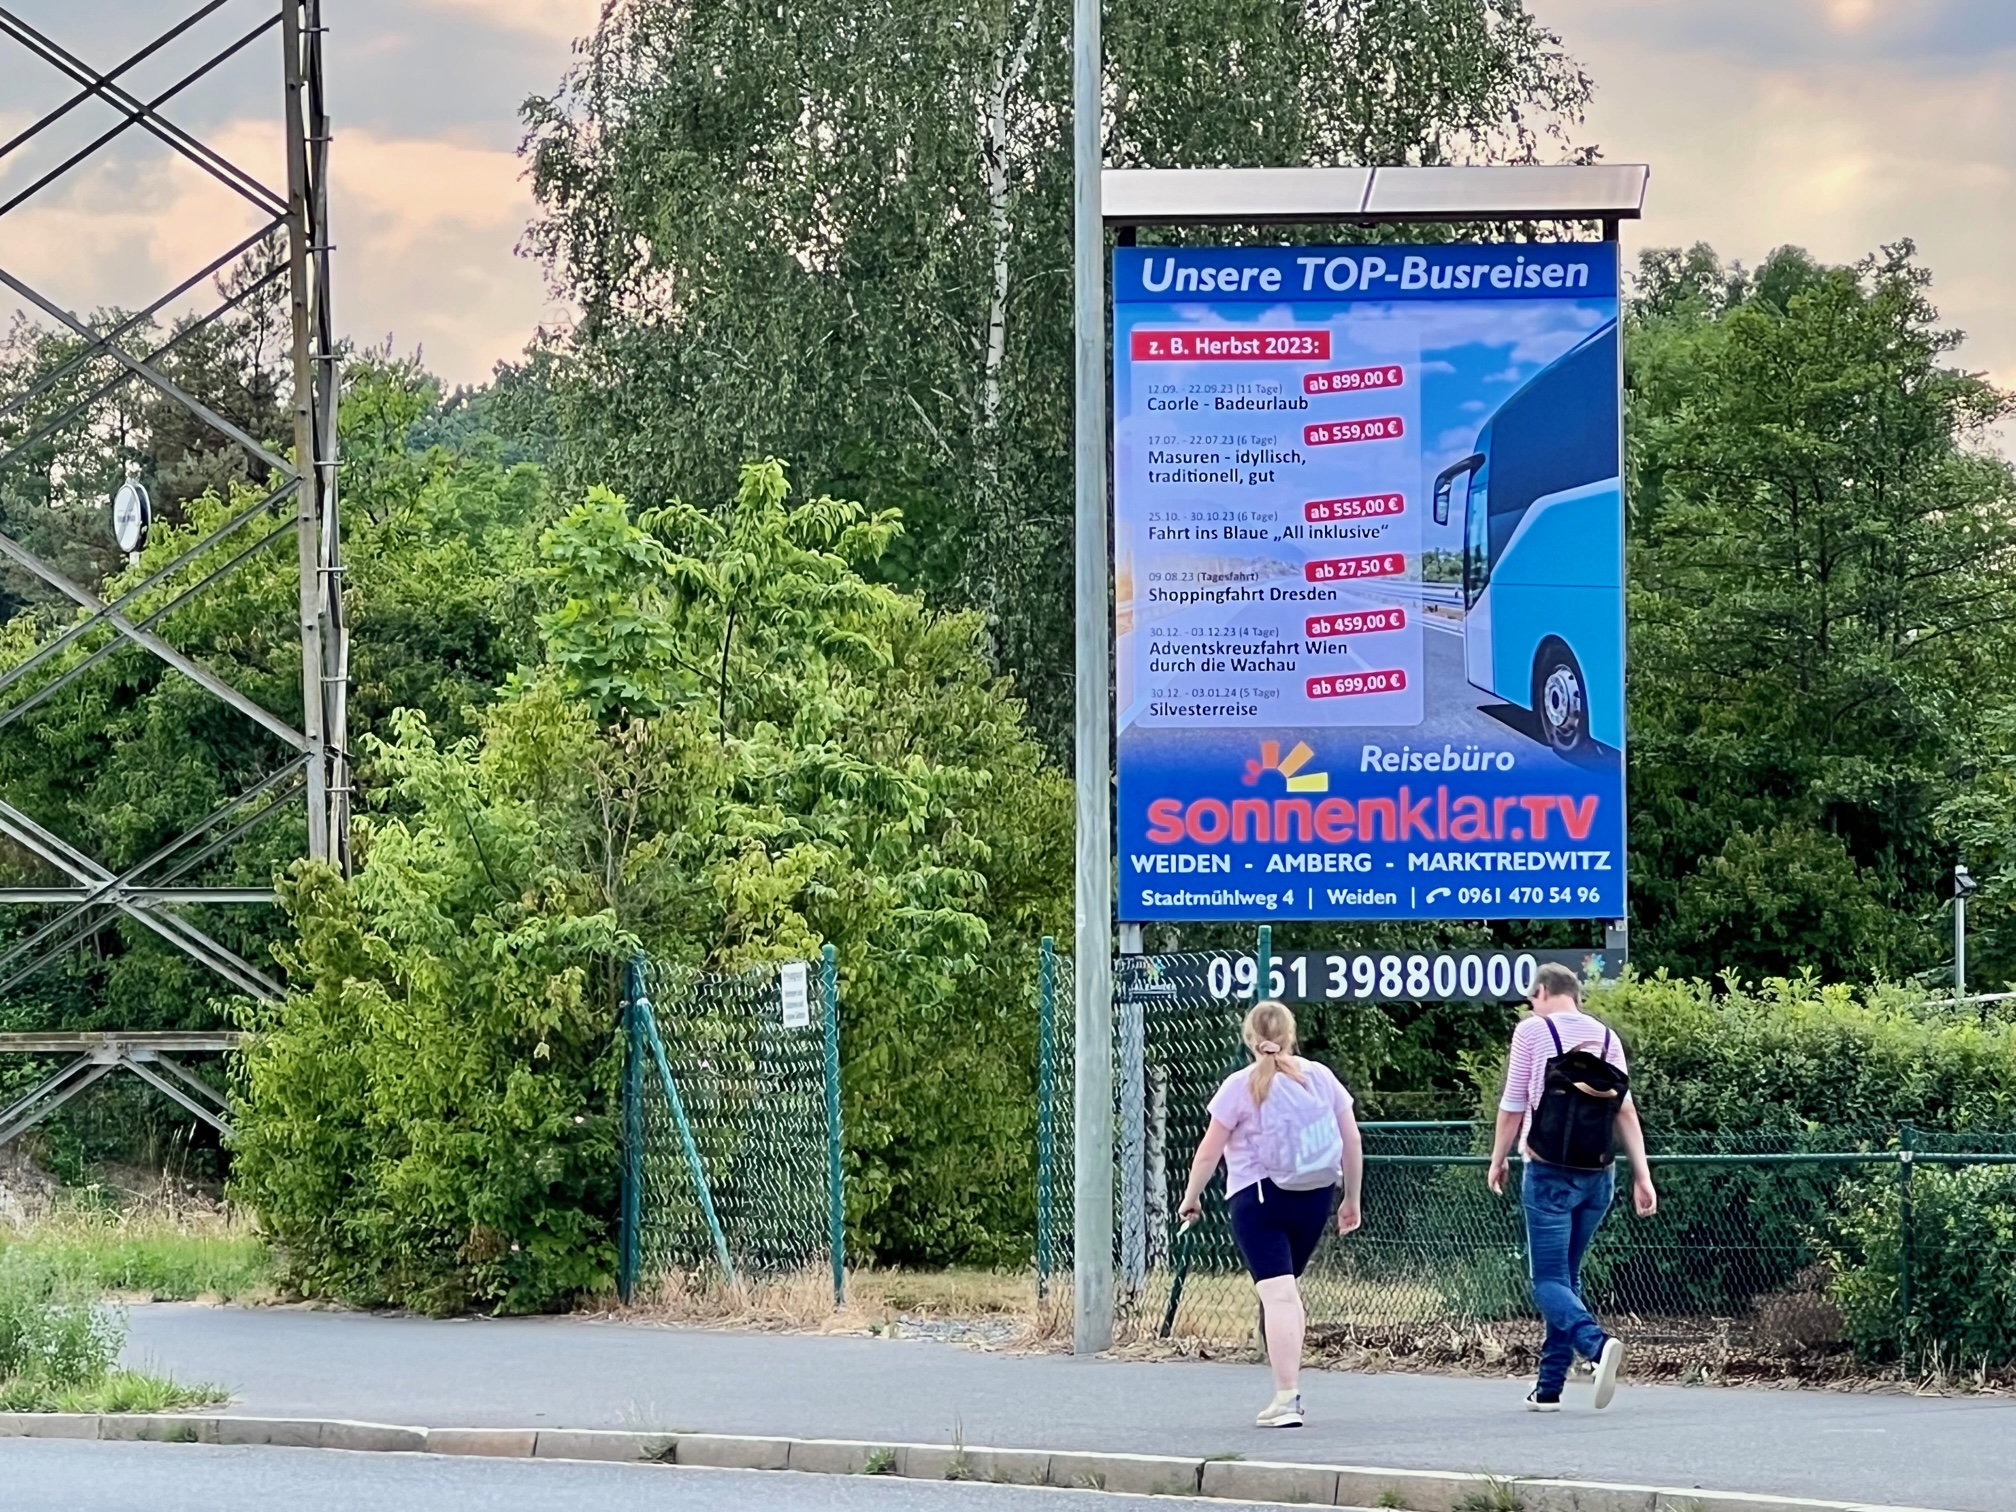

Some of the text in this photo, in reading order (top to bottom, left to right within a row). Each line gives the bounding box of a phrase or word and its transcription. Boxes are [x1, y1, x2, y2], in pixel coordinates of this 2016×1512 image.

[1142, 255, 1589, 292] Unsere TOP-Busreisen
[1149, 336, 1319, 355] z. B. Herbst 2023:
[1309, 369, 1397, 391] ab 899,00 €
[1255, 384, 1283, 395] Tage)
[1147, 396, 1199, 411] Caorle
[1214, 396, 1308, 411] Badeurlaub
[1251, 435, 1277, 446] Tage)
[1310, 421, 1398, 442] ab 559,00 €
[1148, 450, 1220, 464] Masuren
[1235, 449, 1306, 466] idyllisch,
[1148, 469, 1275, 485] traditionell, gut
[1251, 511, 1278, 522] Tage)
[1310, 497, 1399, 519] ab 555,00 €
[1148, 526, 1190, 540] Fahrt
[1195, 525, 1218, 539] ins
[1223, 525, 1268, 540] Blaue
[1197, 571, 1259, 583] (Tagesfahrt)
[1315, 557, 1394, 579] ab 27,50 €
[1148, 587, 1337, 605] Shoppingfahrt Dresden
[1311, 612, 1400, 634] ab 459,00 €
[1252, 627, 1279, 638] Tage)
[1149, 640, 1347, 655] Adventskreuzfahrt Wien
[1149, 658, 1296, 672] durch die Wachau
[1312, 673, 1401, 695] ab 699,00 €
[1252, 688, 1280, 699] Tage)
[1149, 702, 1258, 716] Silvesterreise
[1360, 744, 1515, 773] Reisebüro
[1146, 785, 1599, 844] sonnenklar.TV
[1130, 854, 1231, 873] WEIDEN
[1266, 853, 1372, 873] AMBERG
[1408, 851, 1612, 871] MARKTREDWITZ
[1141, 889, 1278, 910] Stadtmühlweg
[1282, 888, 1294, 905] 4
[1326, 888, 1397, 905] Weiden
[1458, 887, 1501, 904] 0961
[1509, 887, 1544, 904] 470
[1549, 887, 1571, 903] 54
[1577, 886, 1600, 903] 96
[1207, 953, 1538, 1000] 0961 39880000
